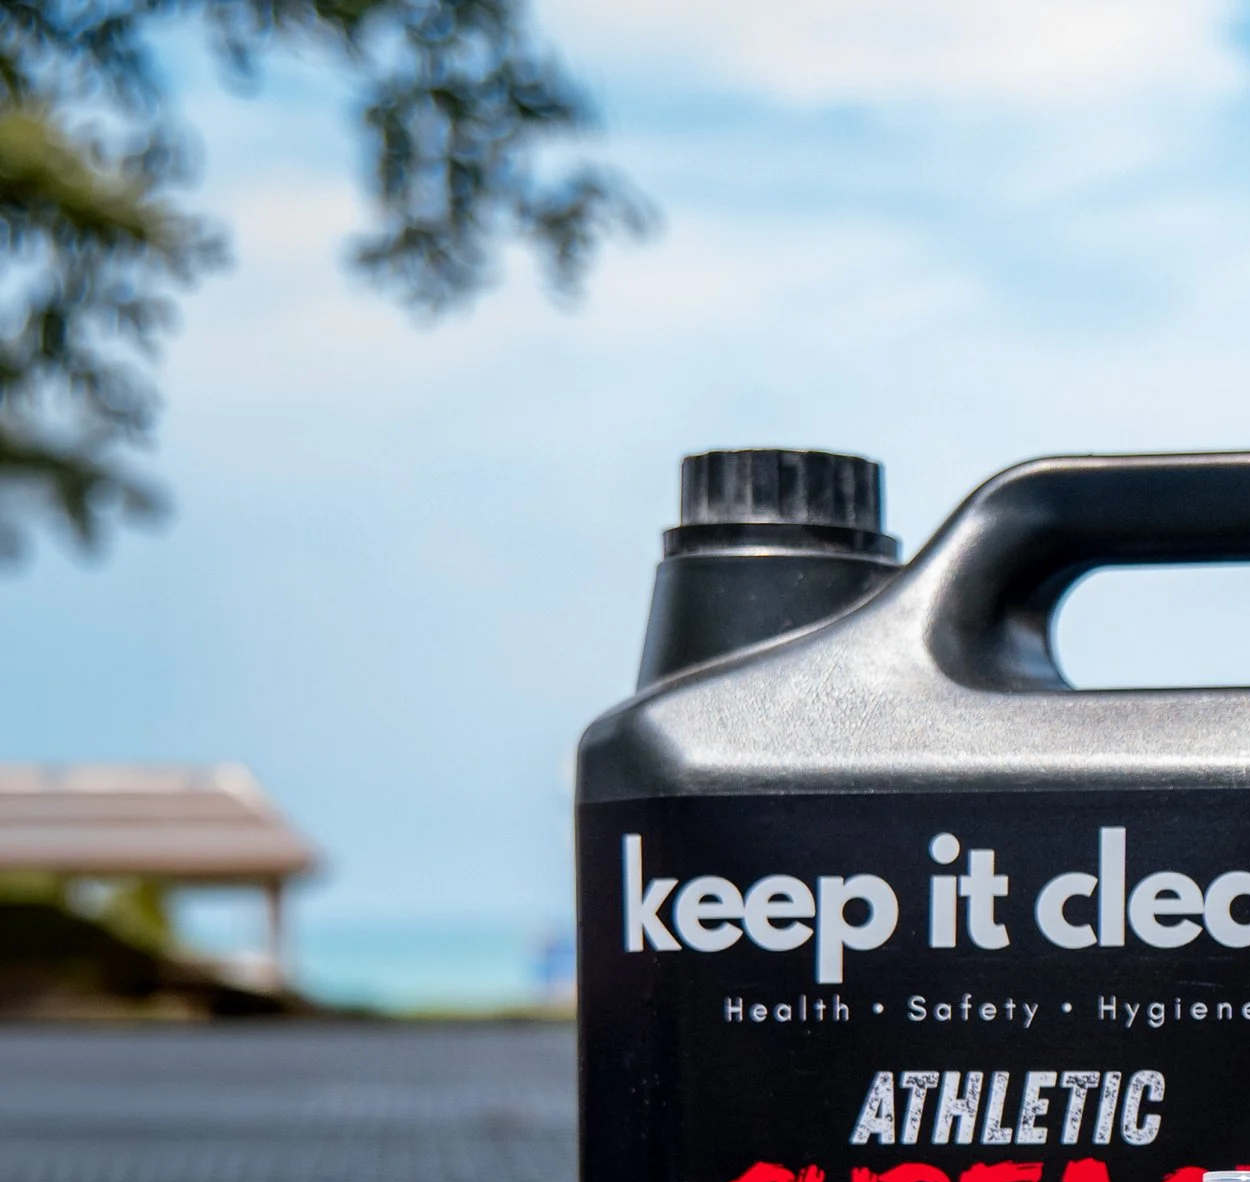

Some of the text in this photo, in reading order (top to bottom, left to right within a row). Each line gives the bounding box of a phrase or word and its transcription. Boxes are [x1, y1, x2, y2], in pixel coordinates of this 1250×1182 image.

[623, 833, 898, 984] keep
[929, 832, 1010, 949] it
[725, 995, 849, 1022] Health
[909, 994, 1039, 1028] Safety
[850, 1070, 1166, 1145] ATHLETIC
